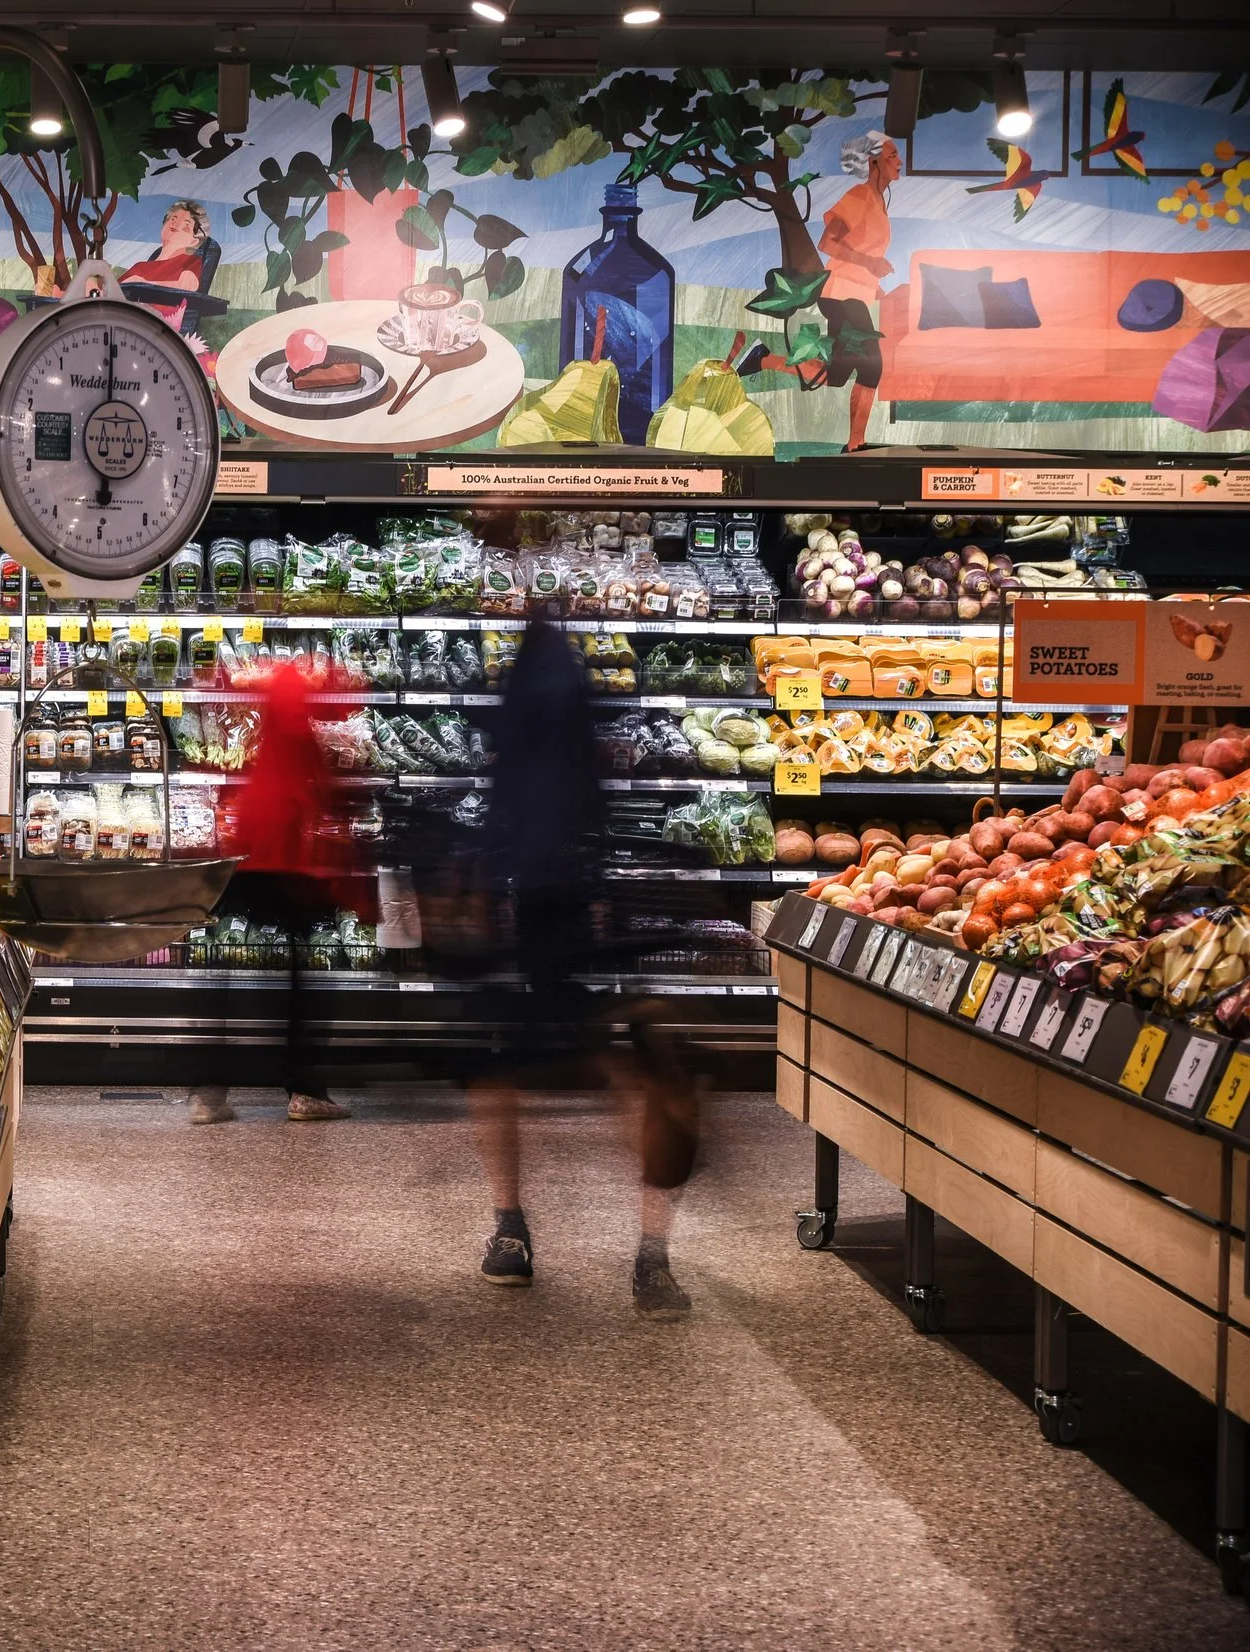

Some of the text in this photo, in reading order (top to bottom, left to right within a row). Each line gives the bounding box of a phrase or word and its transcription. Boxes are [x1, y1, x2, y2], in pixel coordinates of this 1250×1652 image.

[59, 356, 63, 370] 1
[154, 370, 158, 383] 9
[28, 398, 33, 411] 2
[177, 417, 182, 430] 8
[89, 435, 143, 444] WEDDERBURN
[27, 458, 31, 471] 3
[174, 475, 178, 488] 7
[462, 475, 689, 487] 100% Australian Certified Organic Fruit & Veg
[53, 505, 57, 518] 4
[143, 513, 148, 526] 6
[97, 526, 102, 539] 5
[1029, 647, 1090, 660] SWEET
[1029, 662, 1118, 676] POTATOES
[1186, 672, 1214, 680] GOLD
